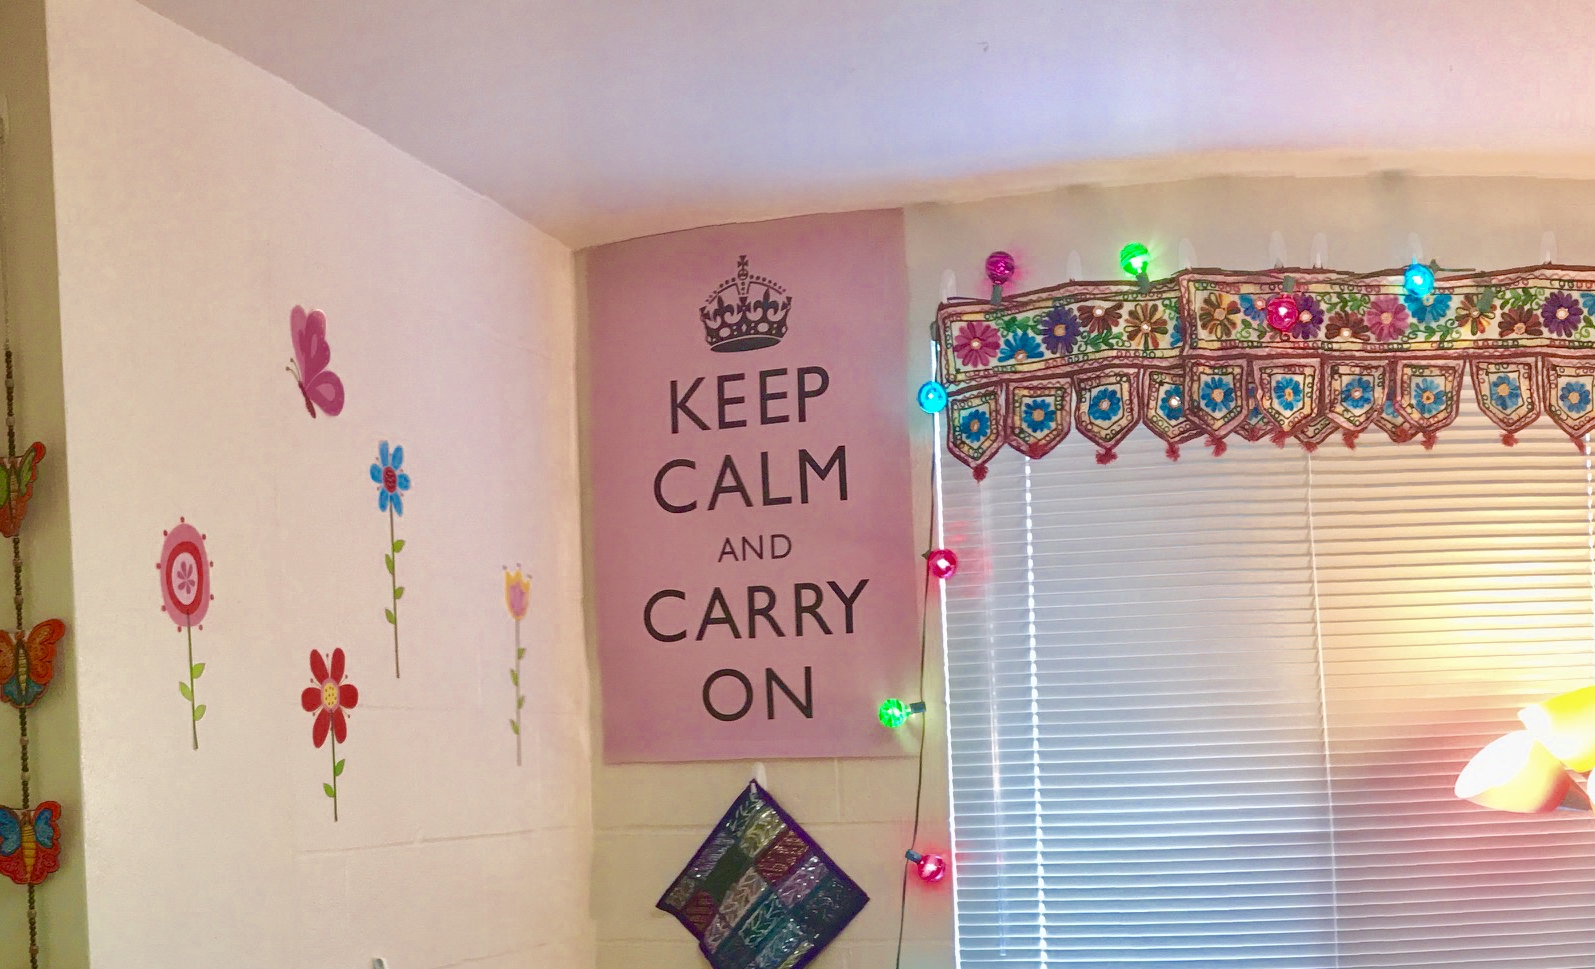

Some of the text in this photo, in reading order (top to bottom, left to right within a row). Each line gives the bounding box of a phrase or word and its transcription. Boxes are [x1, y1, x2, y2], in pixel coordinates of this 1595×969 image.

[669, 366, 830, 434] KEEP
[653, 445, 848, 514] CALM
[717, 533, 793, 562] AND
[643, 579, 870, 642] CARRY
[702, 666, 814, 722] ON
